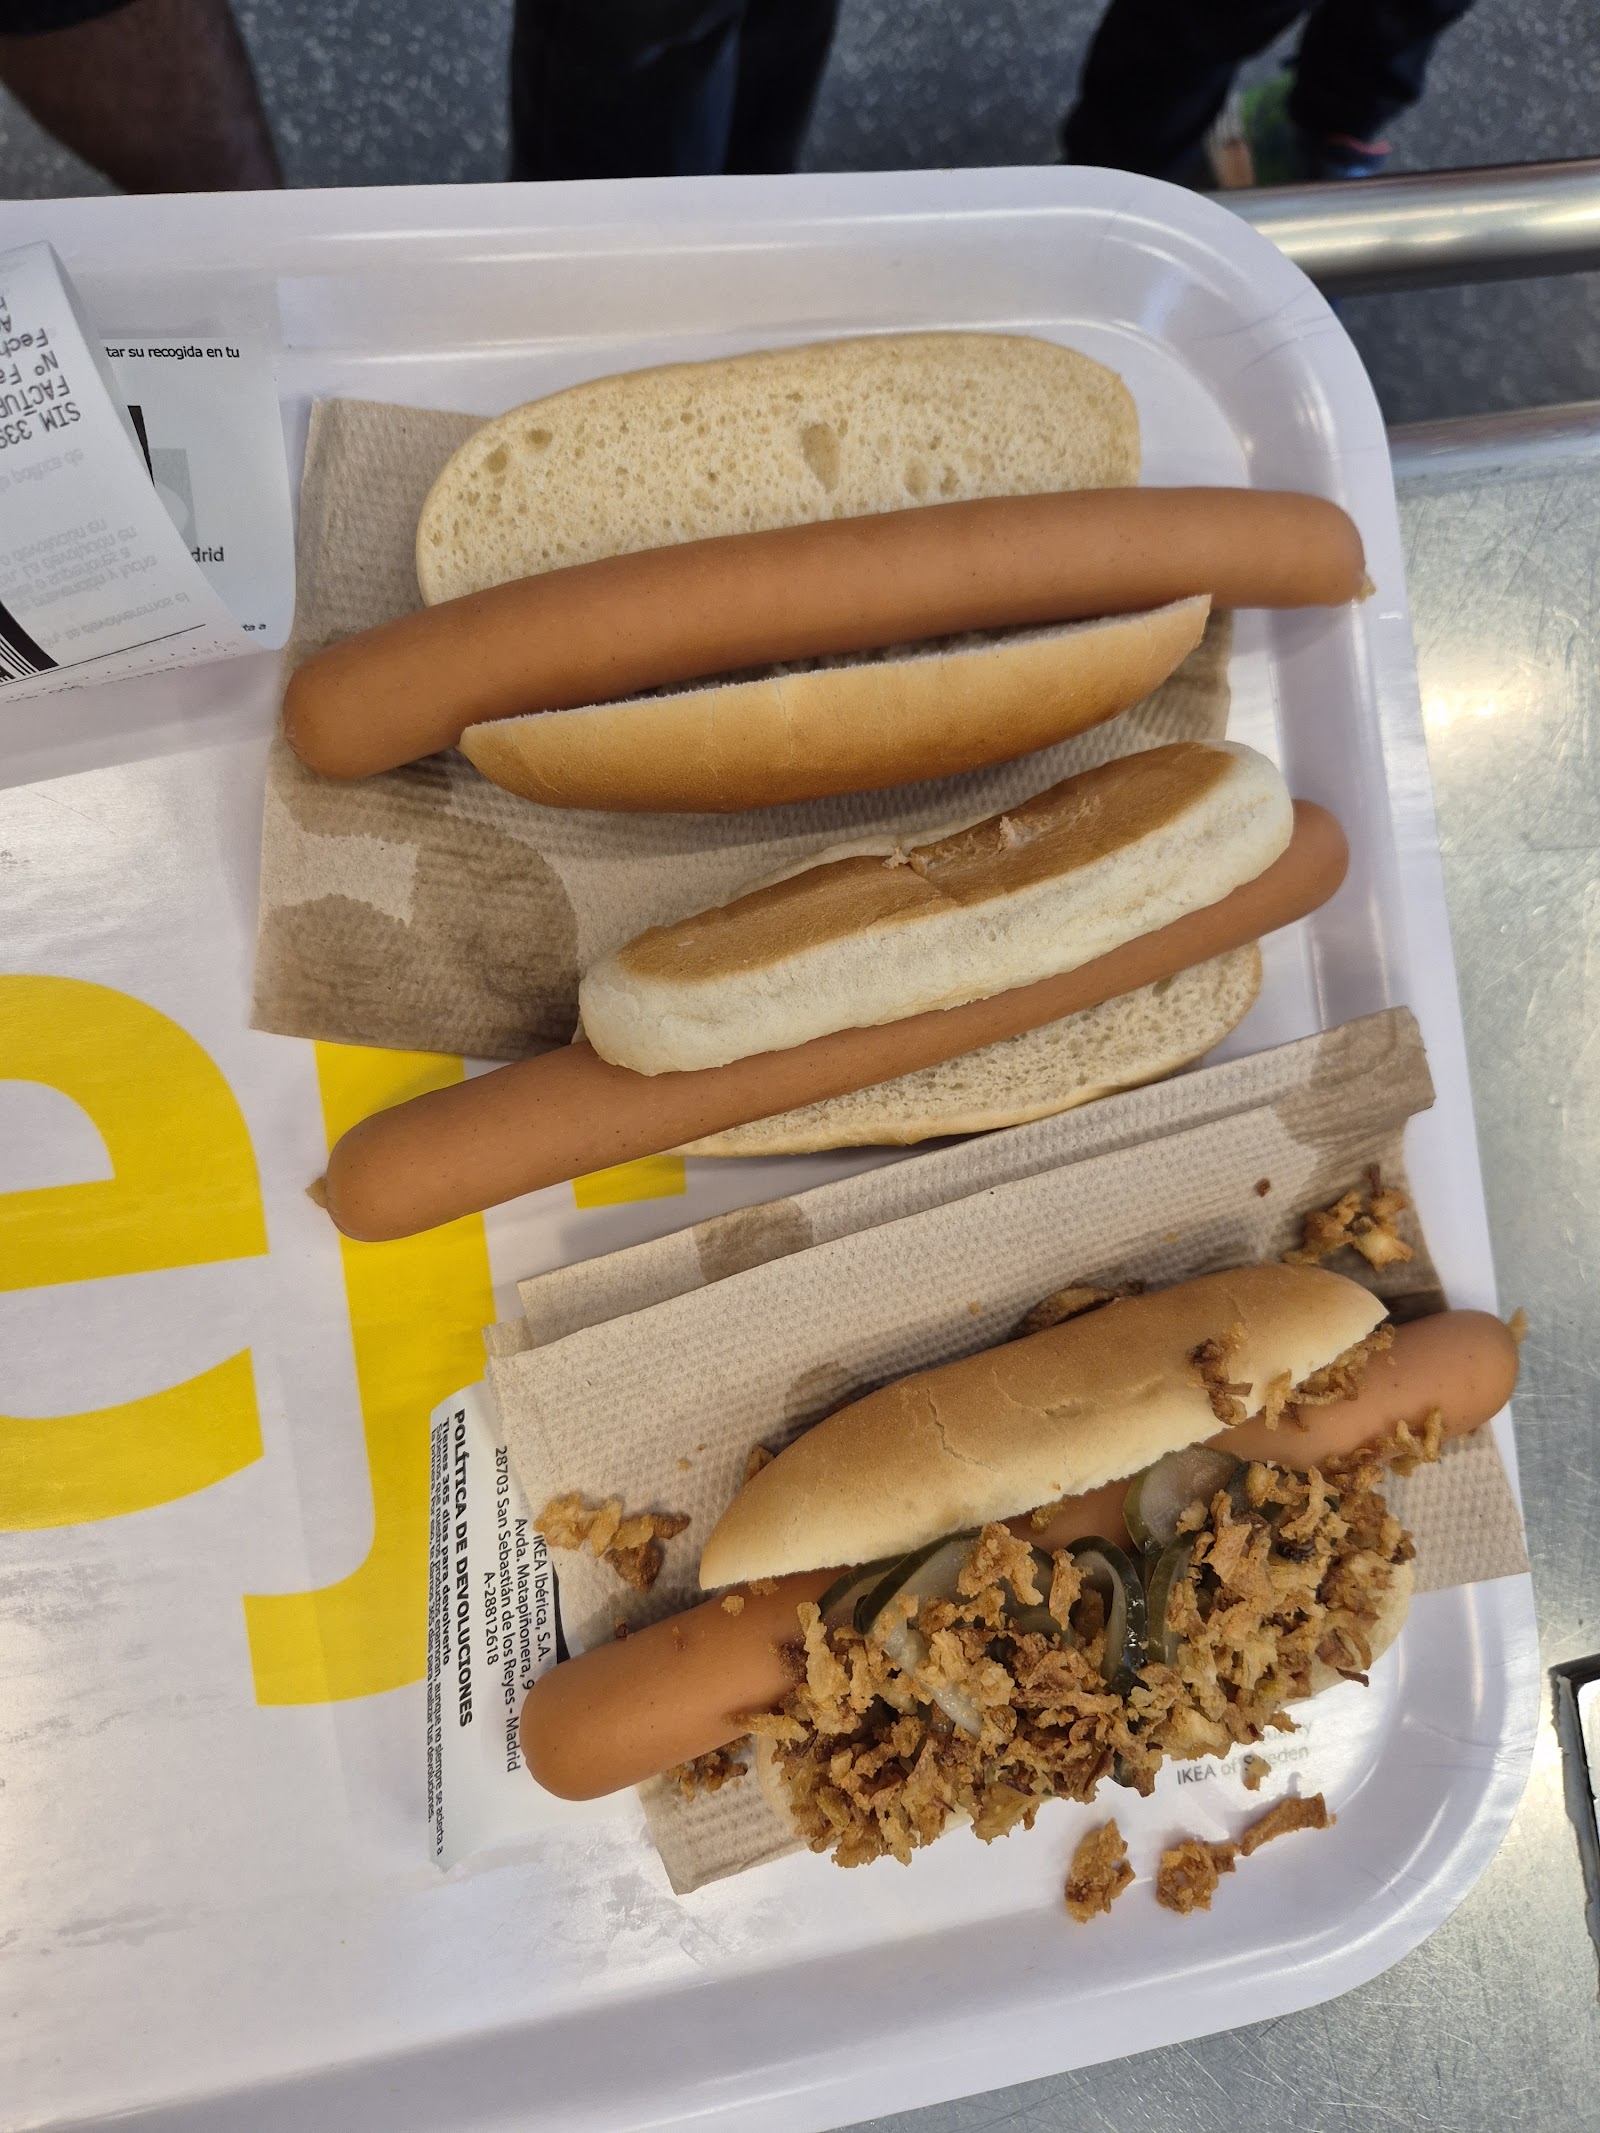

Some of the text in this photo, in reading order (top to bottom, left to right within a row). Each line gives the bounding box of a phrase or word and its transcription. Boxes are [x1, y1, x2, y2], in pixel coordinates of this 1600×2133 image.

[128, 347, 145, 358] su
[148, 345, 204, 360] recogida
[206, 347, 223, 358] en
[225, 346, 240, 358] tu
[495, 1445, 509, 1496] 28703
[497, 1497, 510, 1529] San
[441, 1416, 451, 1666] Tienes 365 días para devolverlo
[454, 1408, 472, 1727] POLÍTICA DE DEVOLUCIONES
[498, 1530, 514, 1608] Sebastián
[484, 1572, 499, 1666] A-28812618
[501, 1610, 516, 1631] de
[514, 1518, 535, 1690] Avda. Matapiñonera, 9
[533, 1534, 551, 1662] IKEA Ibérica, S.A.
[502, 1632, 516, 1658] los
[501, 1658, 517, 1705] Reyes
[505, 1716, 521, 1772] Madrid
[1177, 1746, 1310, 1786] IKEA of Seden
